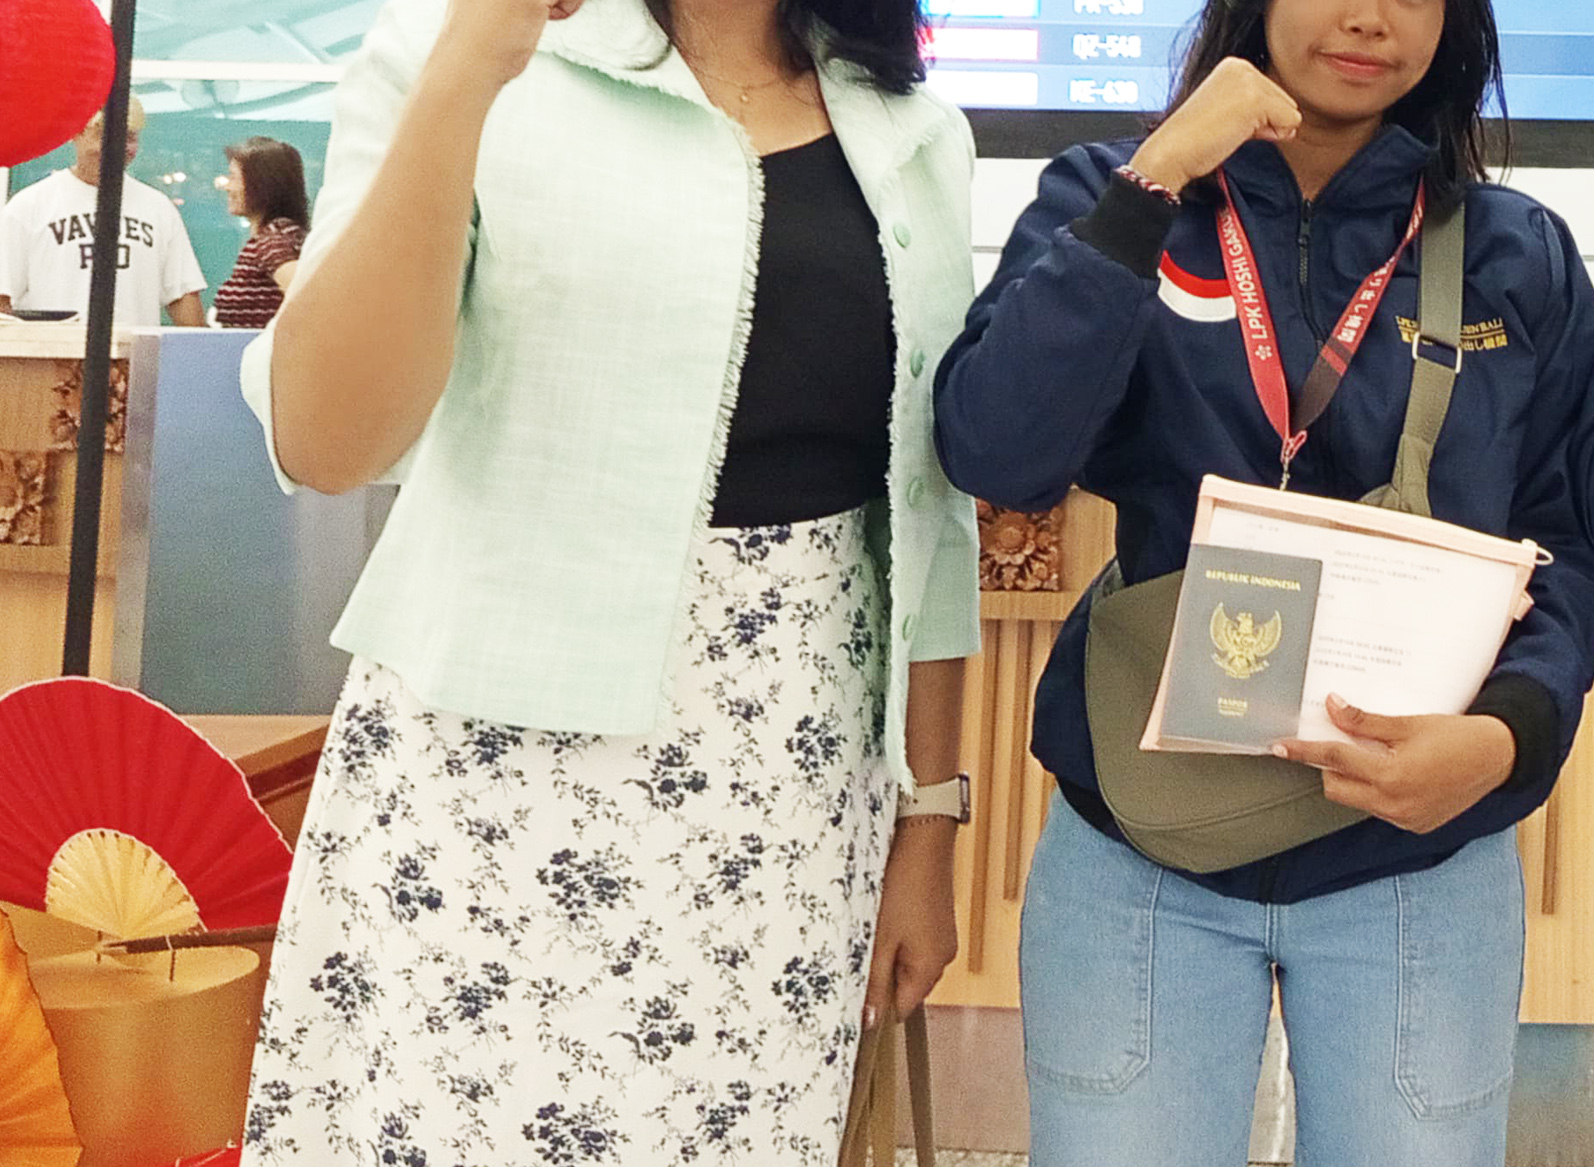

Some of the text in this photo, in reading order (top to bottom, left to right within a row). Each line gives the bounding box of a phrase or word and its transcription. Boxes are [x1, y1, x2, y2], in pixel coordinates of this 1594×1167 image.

[1232, 256, 1268, 339] LPK HOSHI
[1206, 570, 1301, 592] REPUBLIK INDONESIA
